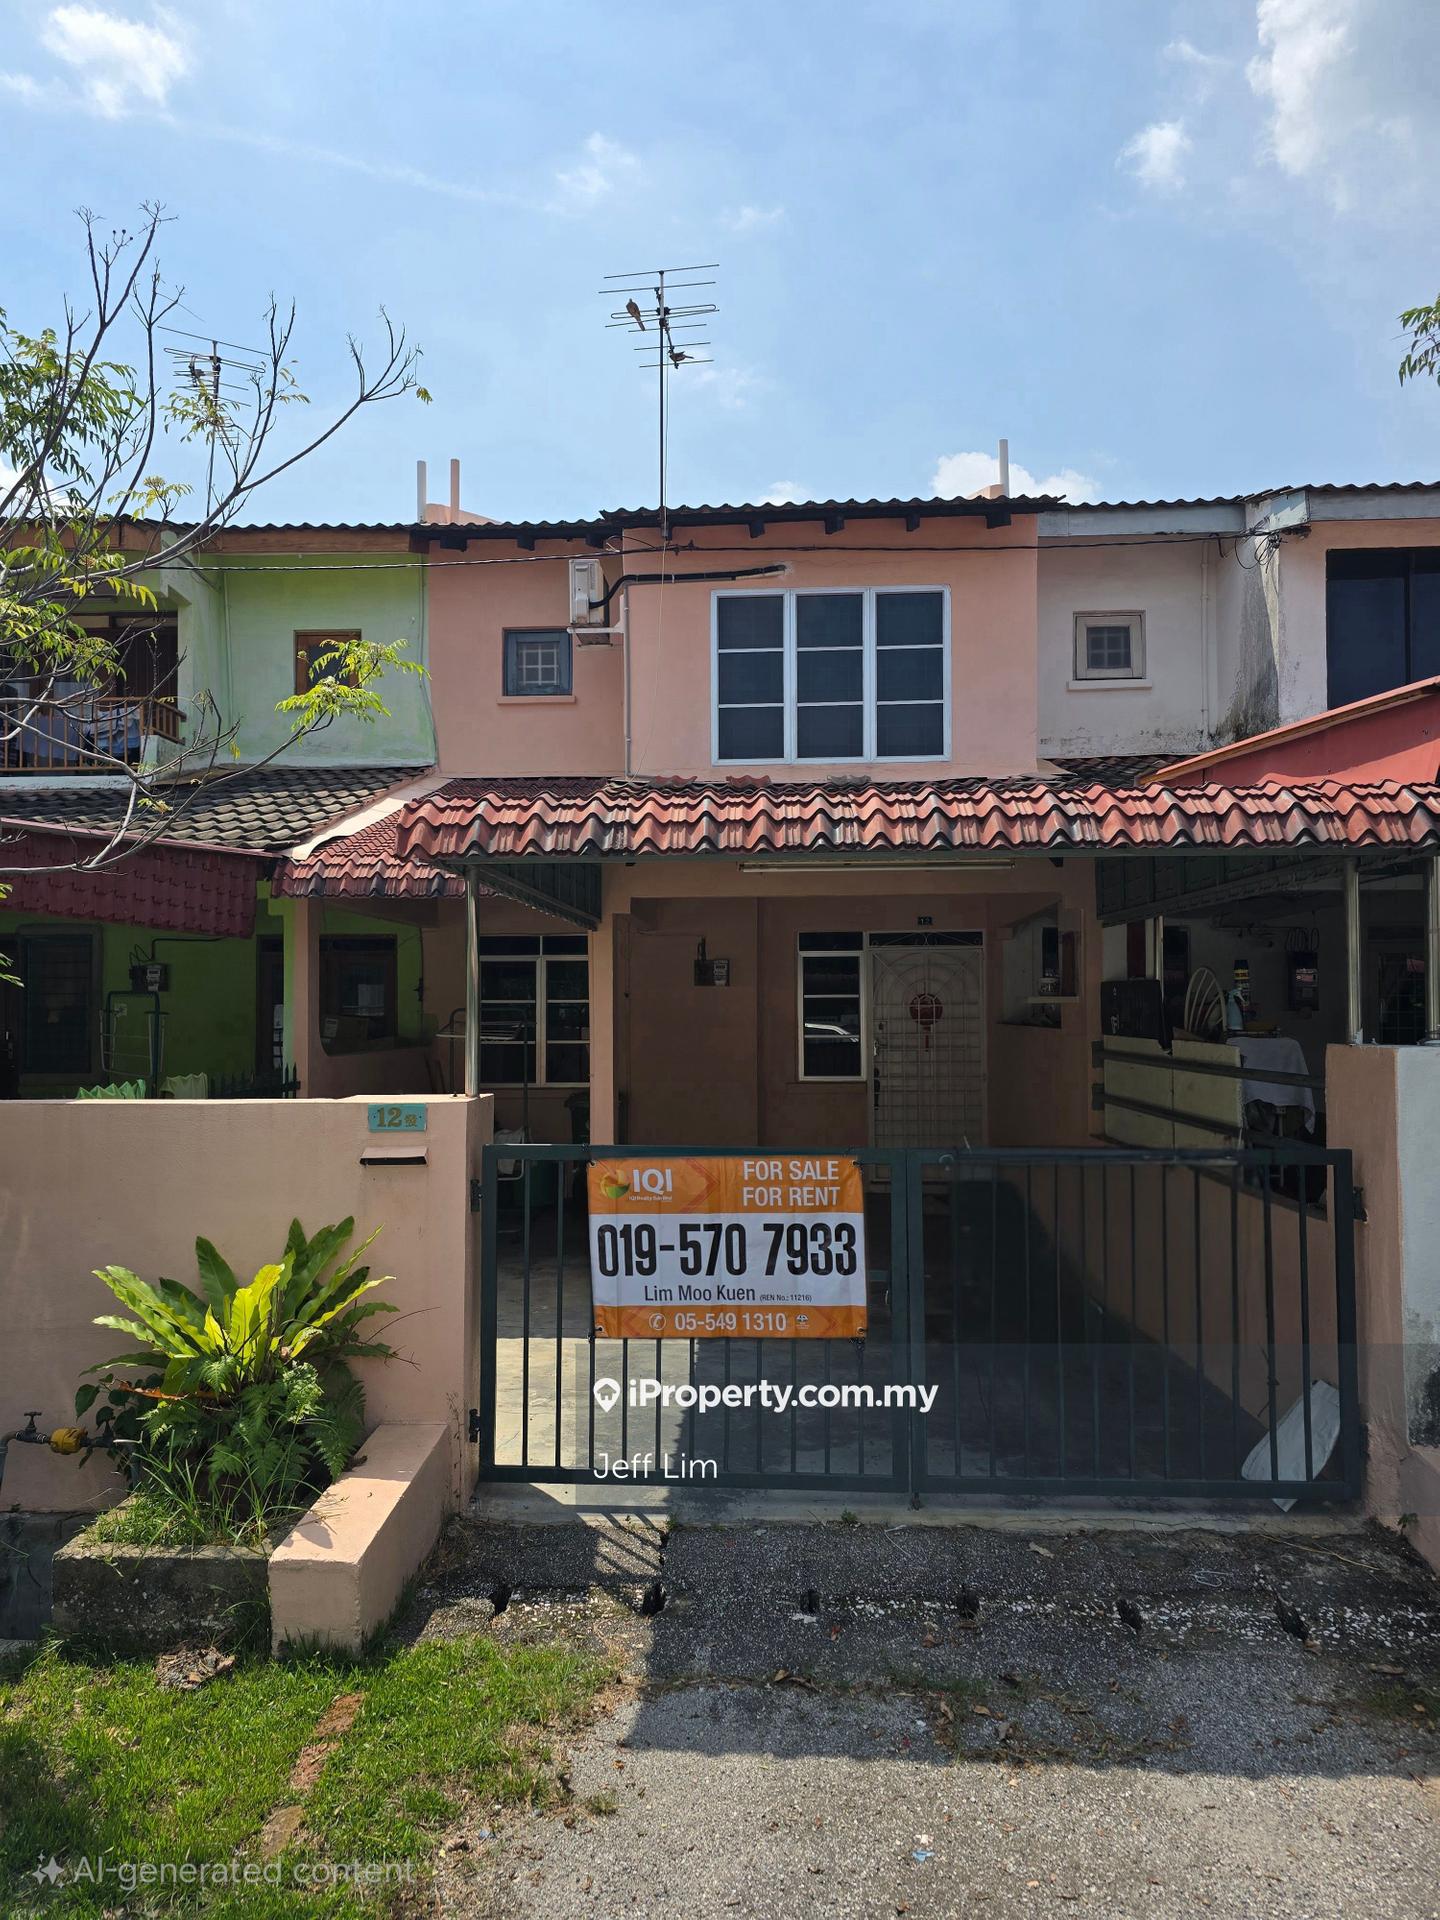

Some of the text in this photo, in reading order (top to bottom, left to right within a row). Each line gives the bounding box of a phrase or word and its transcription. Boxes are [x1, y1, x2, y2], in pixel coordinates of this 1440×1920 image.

[743, 1160, 840, 1181] FOR SALE
[633, 1168, 673, 1195] IQI
[743, 1186, 840, 1207] FOR RENT
[597, 1222, 857, 1277] 019-570 7933
[644, 1285, 673, 1302] Lim
[678, 1285, 712, 1301] Moo
[717, 1285, 756, 1301] Kuen
[674, 1312, 787, 1331] 05-549 1310
